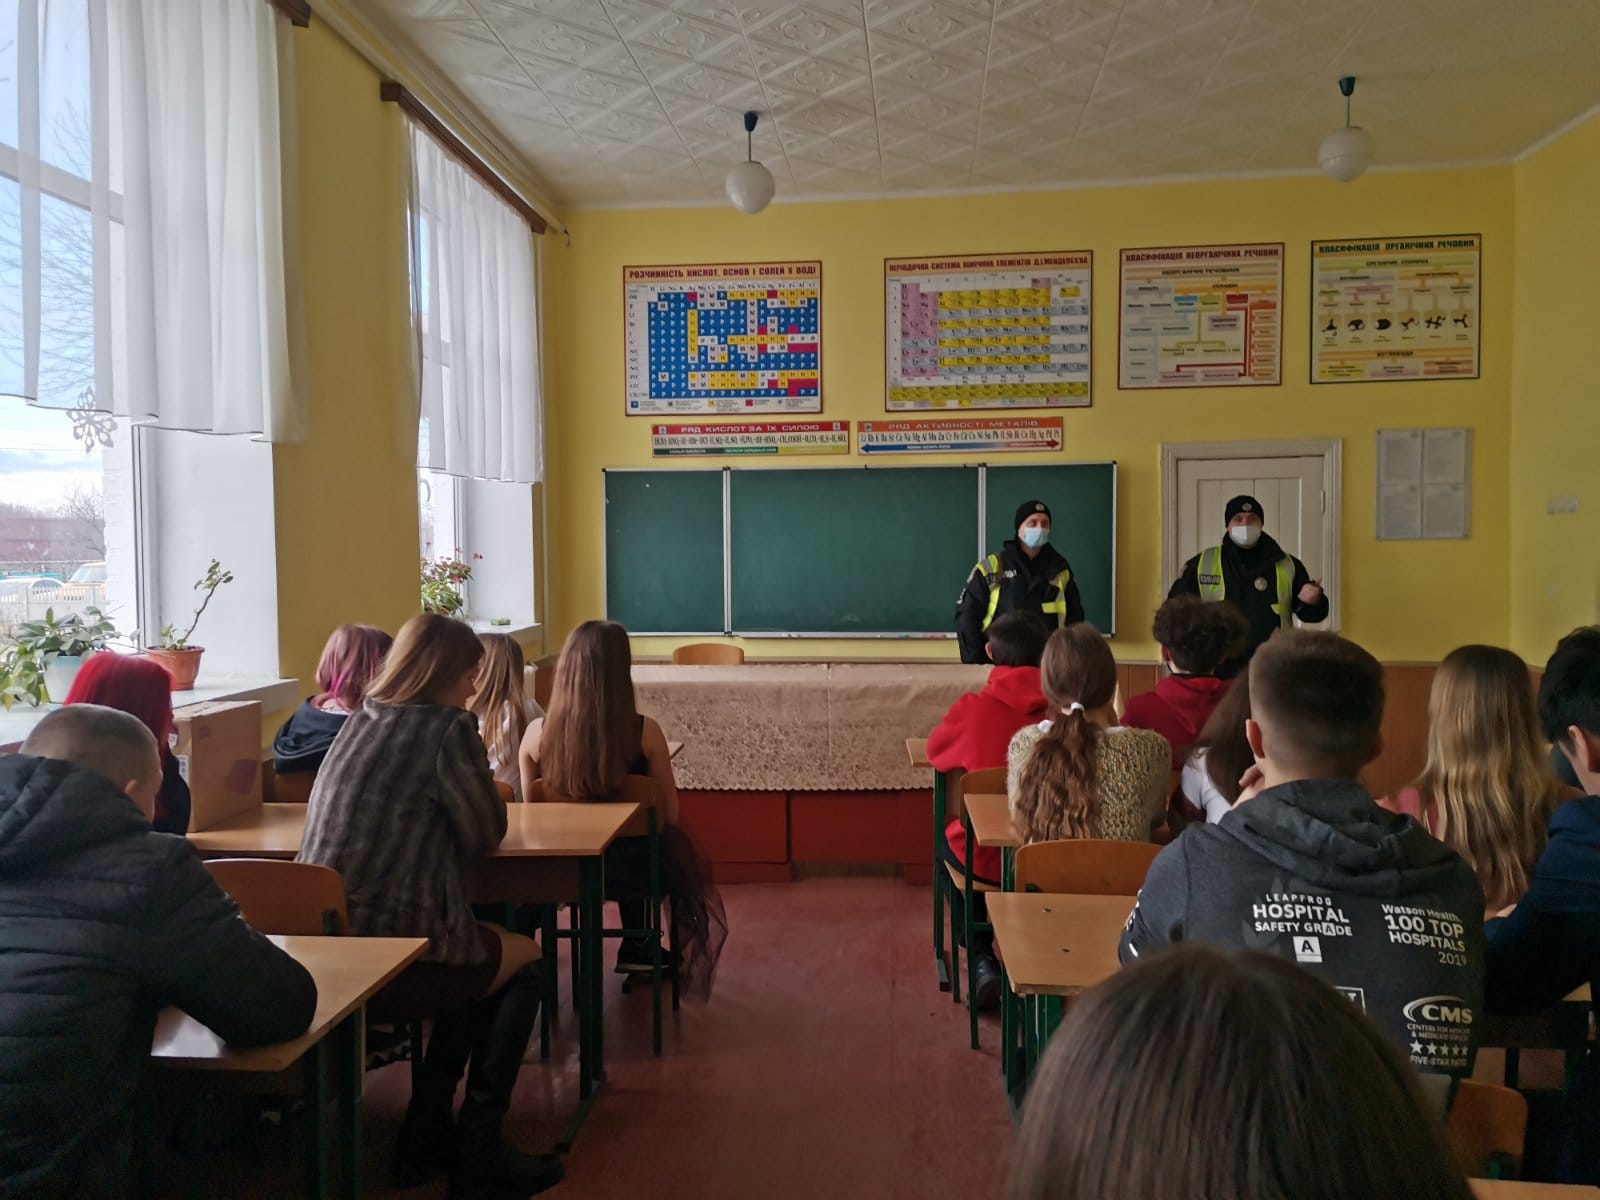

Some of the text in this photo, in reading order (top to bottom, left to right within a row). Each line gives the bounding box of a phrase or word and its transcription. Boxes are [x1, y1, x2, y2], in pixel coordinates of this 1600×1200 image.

[1319, 240, 1474, 254] КЛАСИФІКАЦІЯ ОРГАНІЧНИХ РЕЧОВИН
[1126, 248, 1278, 262] КЛАСИФІКАЦІЯ НЕОРГАНІЧНИХ РЕЧОВИН
[630, 270, 683, 278] РОЗЧИННІСТЬ
[759, 266, 784, 275] СОЛЕЙ
[796, 266, 816, 274] ВОДІ
[889, 263, 929, 272] ПЕРІОДИЧНА
[1266, 894, 1332, 907] LEAPFROG
[1253, 904, 1350, 924] HOSPITAL
[1381, 903, 1425, 917] Watson
[1255, 921, 1353, 937] SAFETY GRADE
[1384, 914, 1464, 937] 100 TOP
[1301, 940, 1314, 953] A
[1389, 930, 1466, 953] HOSPITALS
[1439, 951, 1467, 967] 2019
[1421, 1004, 1473, 1024] CMS
[1407, 1023, 1435, 1032] CENTERS
